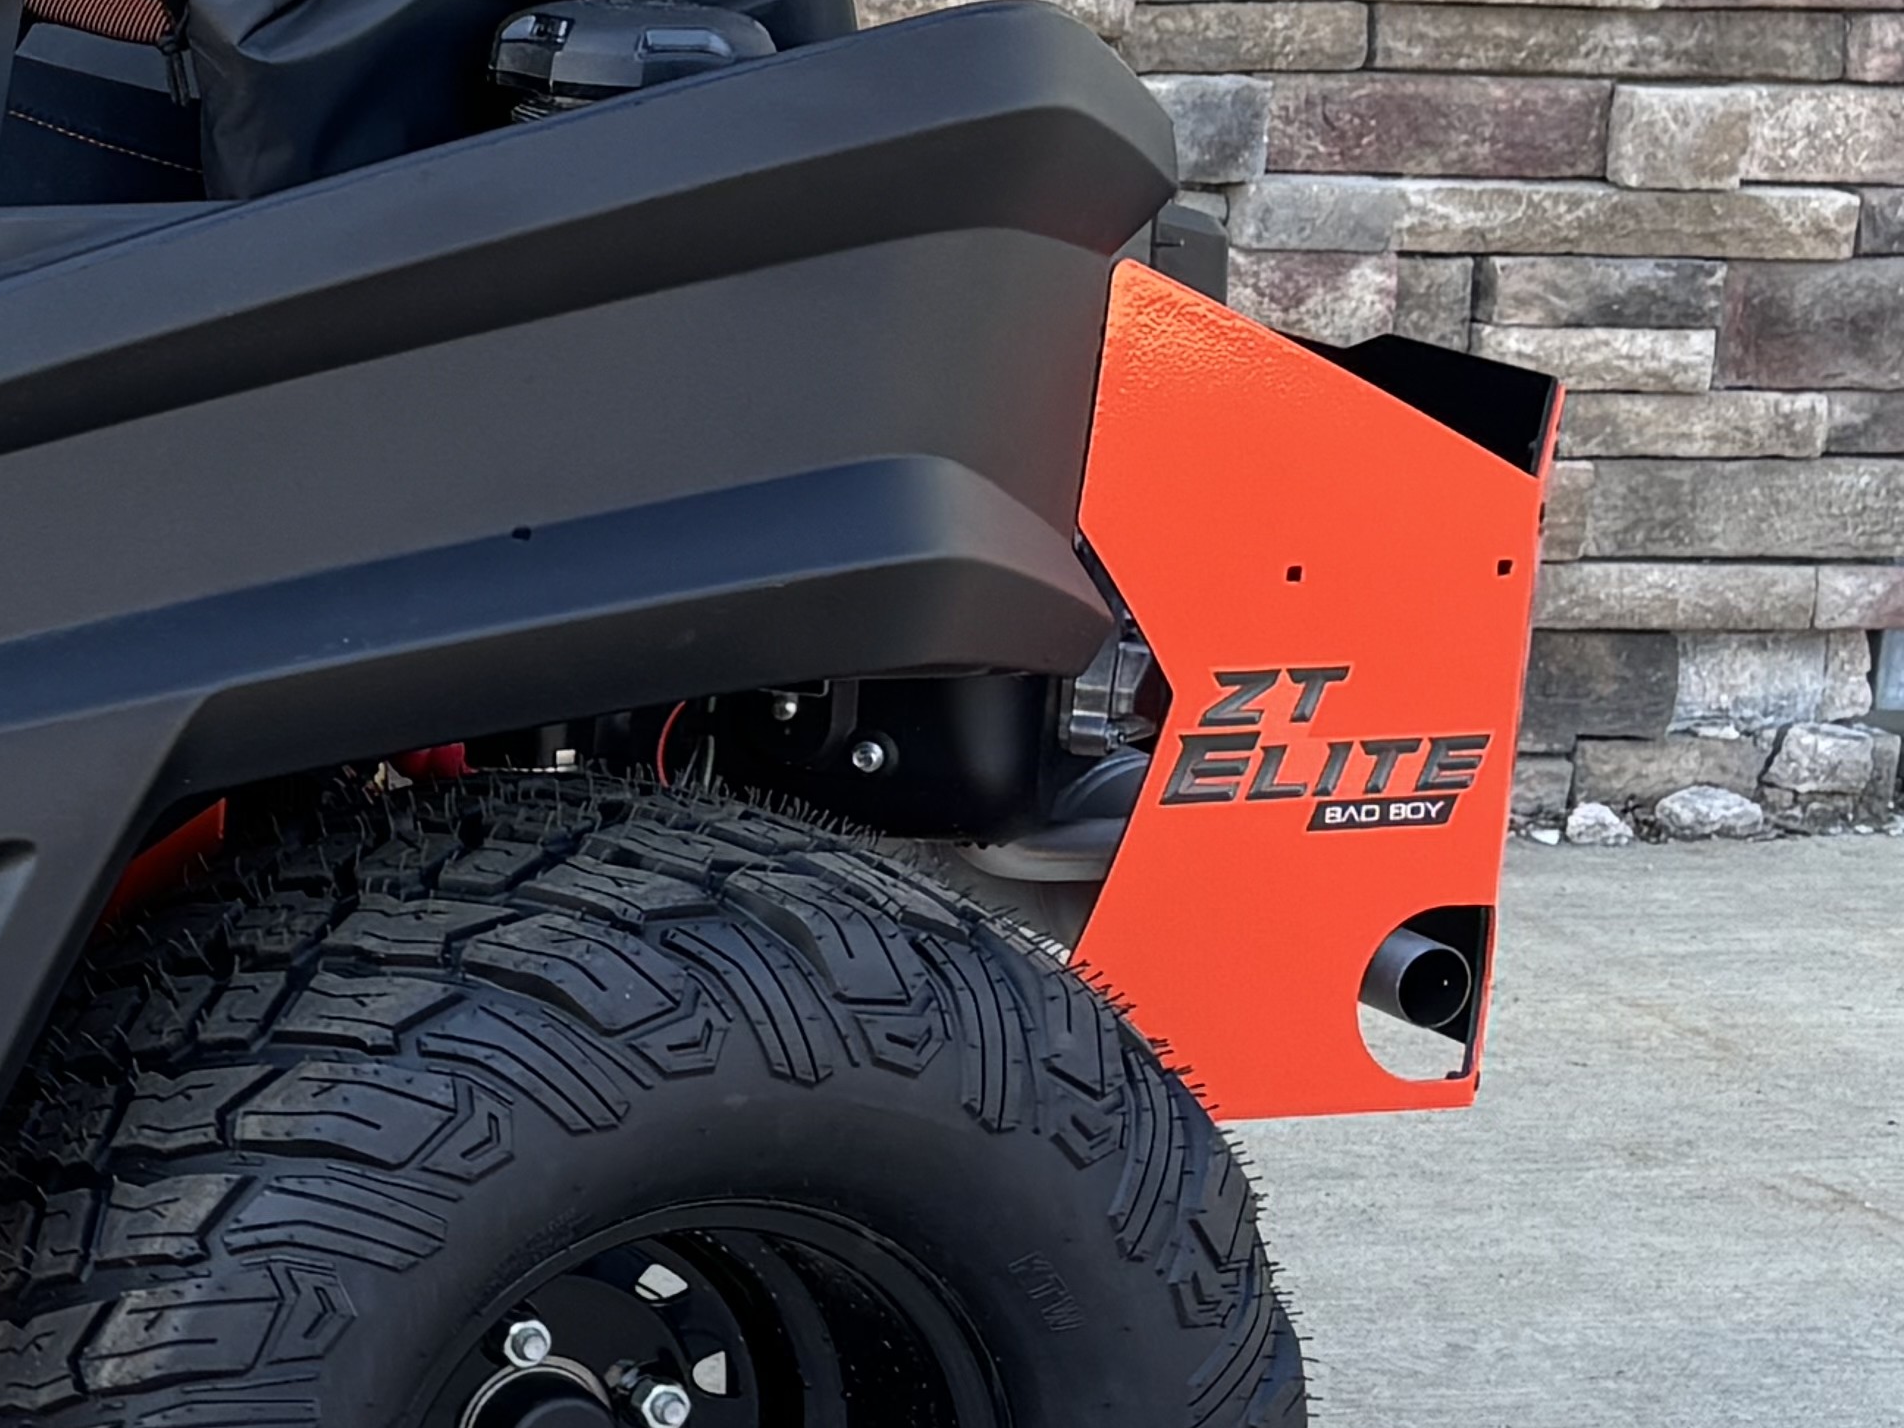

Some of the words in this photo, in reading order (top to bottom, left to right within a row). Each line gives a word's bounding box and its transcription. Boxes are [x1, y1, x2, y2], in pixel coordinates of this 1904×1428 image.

[1197, 665, 1353, 728] ZT
[1159, 730, 1493, 805] ELITE
[1323, 803, 1382, 825] BAD
[1388, 800, 1447, 822] BOY
